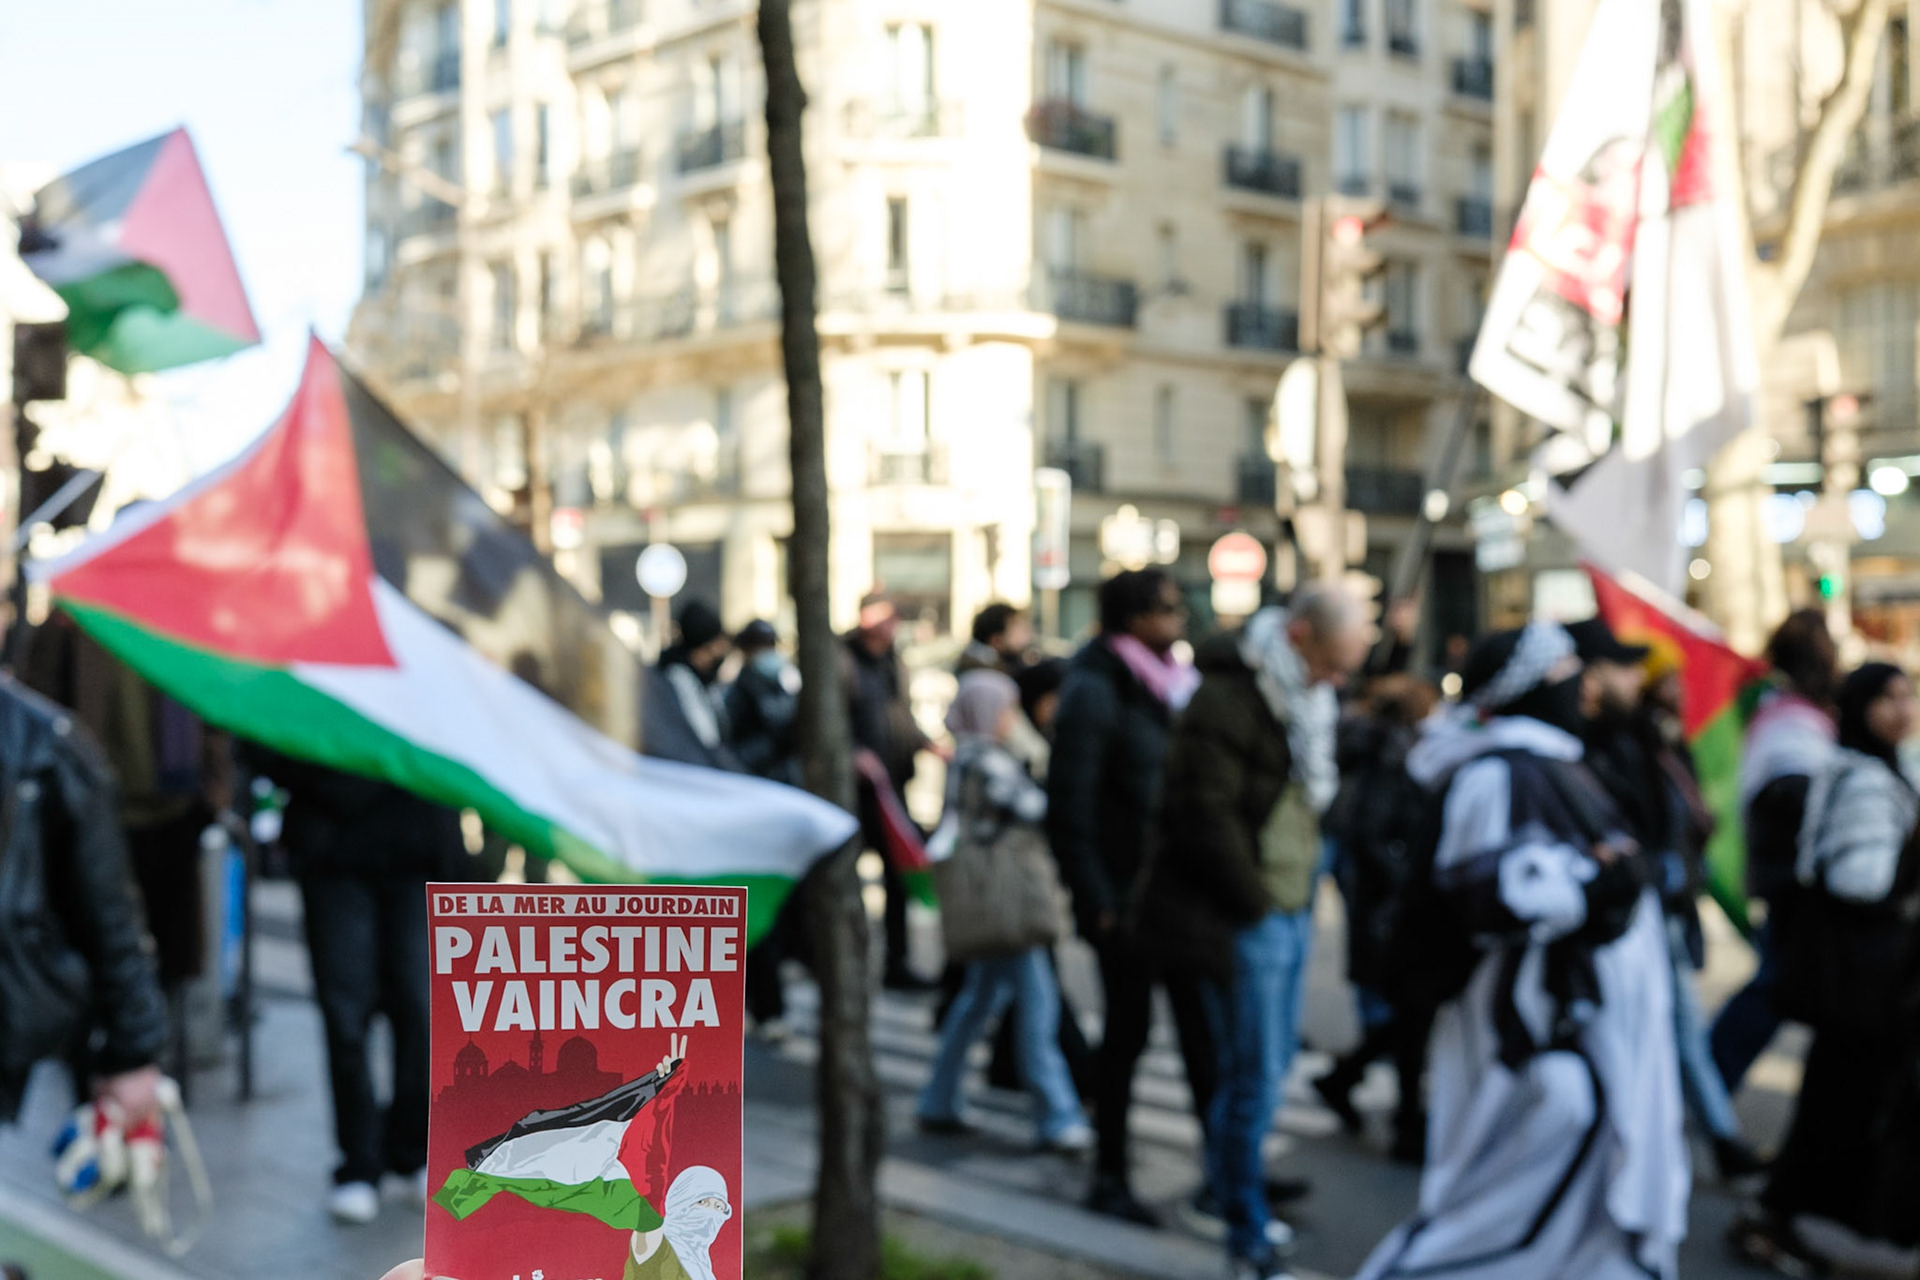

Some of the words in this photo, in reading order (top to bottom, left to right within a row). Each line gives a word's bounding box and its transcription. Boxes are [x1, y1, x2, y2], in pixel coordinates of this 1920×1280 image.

[438, 896, 468, 914] DE
[477, 896, 505, 914] LA
[514, 896, 566, 914] MER
[574, 896, 607, 915] AU
[615, 896, 734, 915] JOURDAIN
[434, 925, 738, 974] PALESTINE
[451, 978, 721, 1032] VAINCRA
